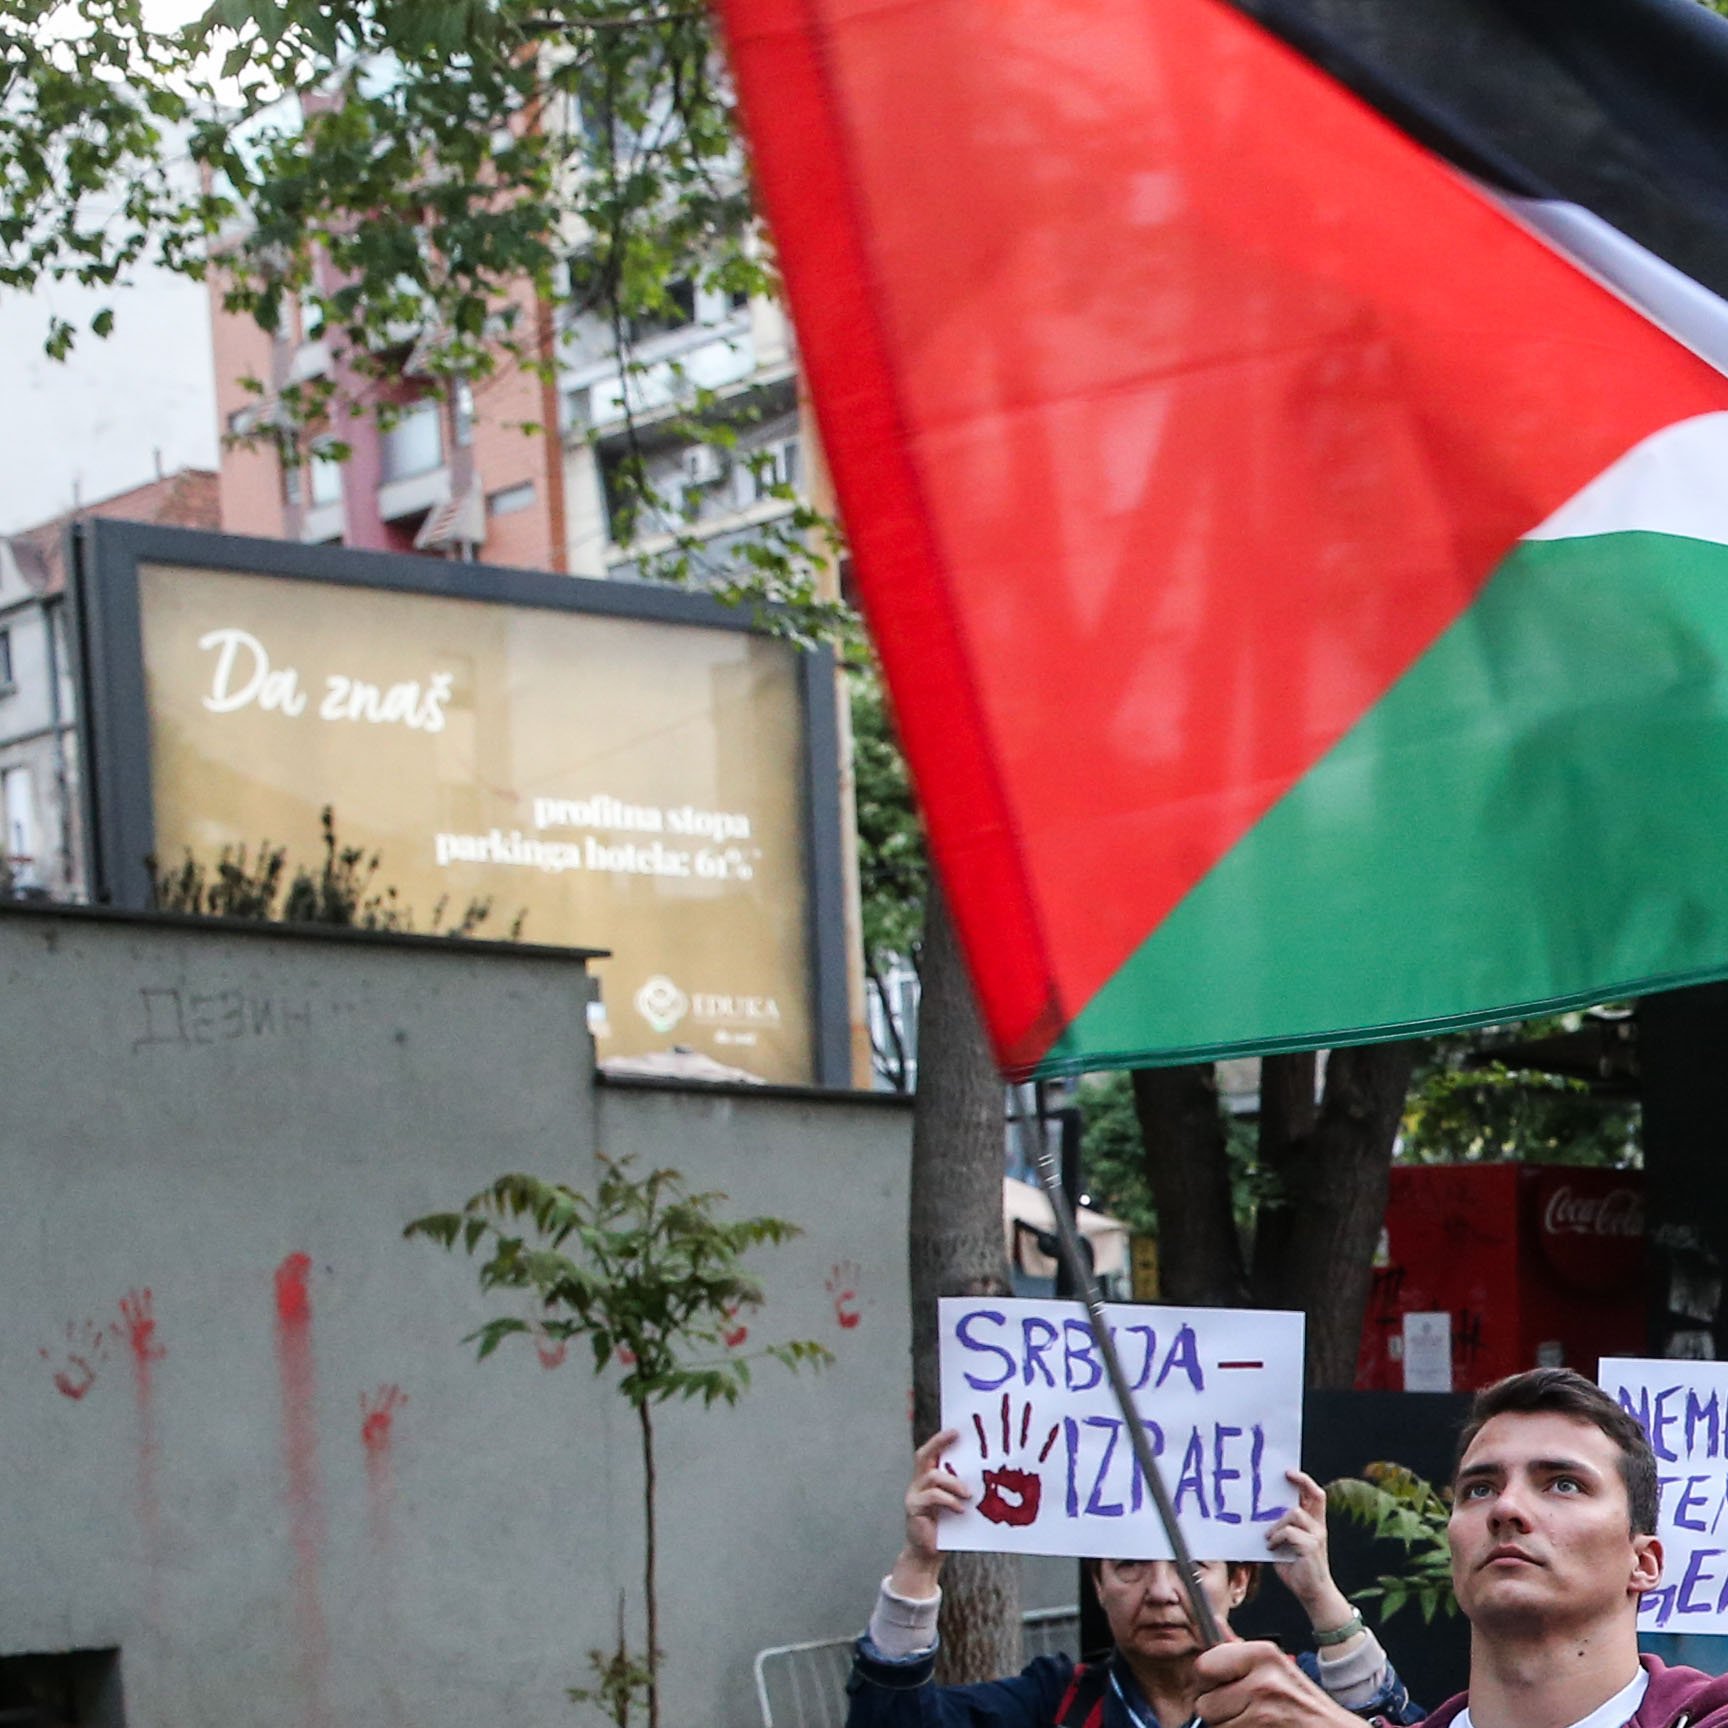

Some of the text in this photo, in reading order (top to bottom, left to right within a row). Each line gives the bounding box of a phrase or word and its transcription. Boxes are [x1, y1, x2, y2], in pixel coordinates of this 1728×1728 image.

[198, 627, 452, 734] Da znaš
[533, 793, 750, 843] profitna stopa
[435, 827, 581, 873] parkinga
[584, 836, 691, 877] hotela:
